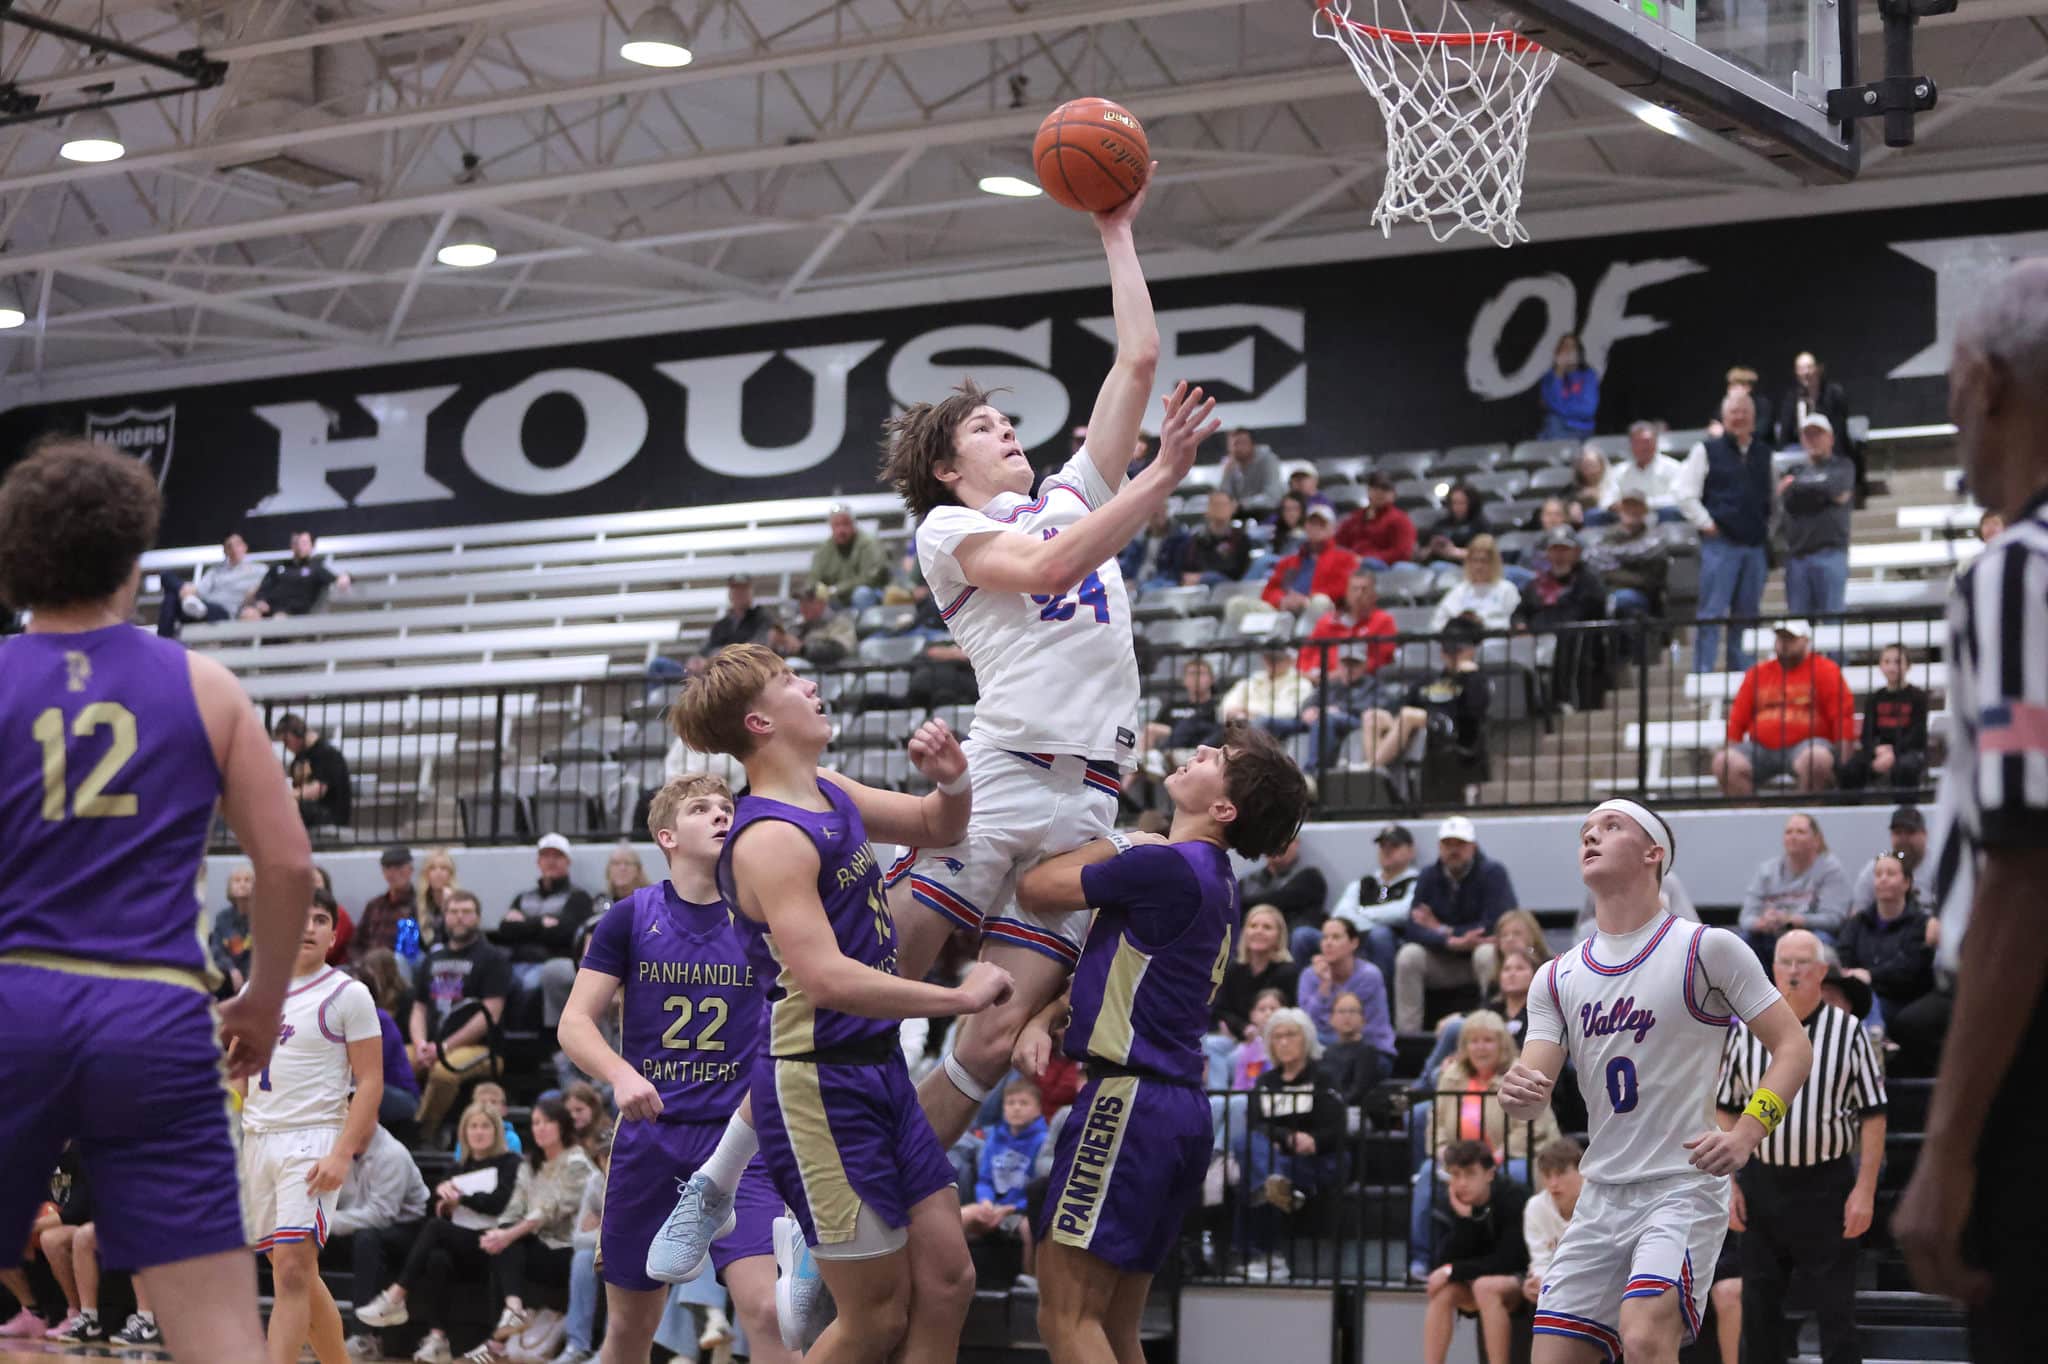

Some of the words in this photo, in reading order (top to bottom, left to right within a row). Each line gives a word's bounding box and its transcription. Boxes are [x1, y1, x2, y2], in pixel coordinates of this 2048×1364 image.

[247, 303, 1308, 517] HOUSE
[1465, 256, 1710, 400] OF
[32, 701, 139, 822] 12
[639, 961, 753, 987] PANHANDLE
[661, 995, 728, 1051] 22
[1581, 995, 1656, 1044] Valley
[643, 1058, 740, 1082] PANTHERS
[1605, 1055, 1639, 1114] 0
[1057, 1095, 1124, 1236] PANTHERS
